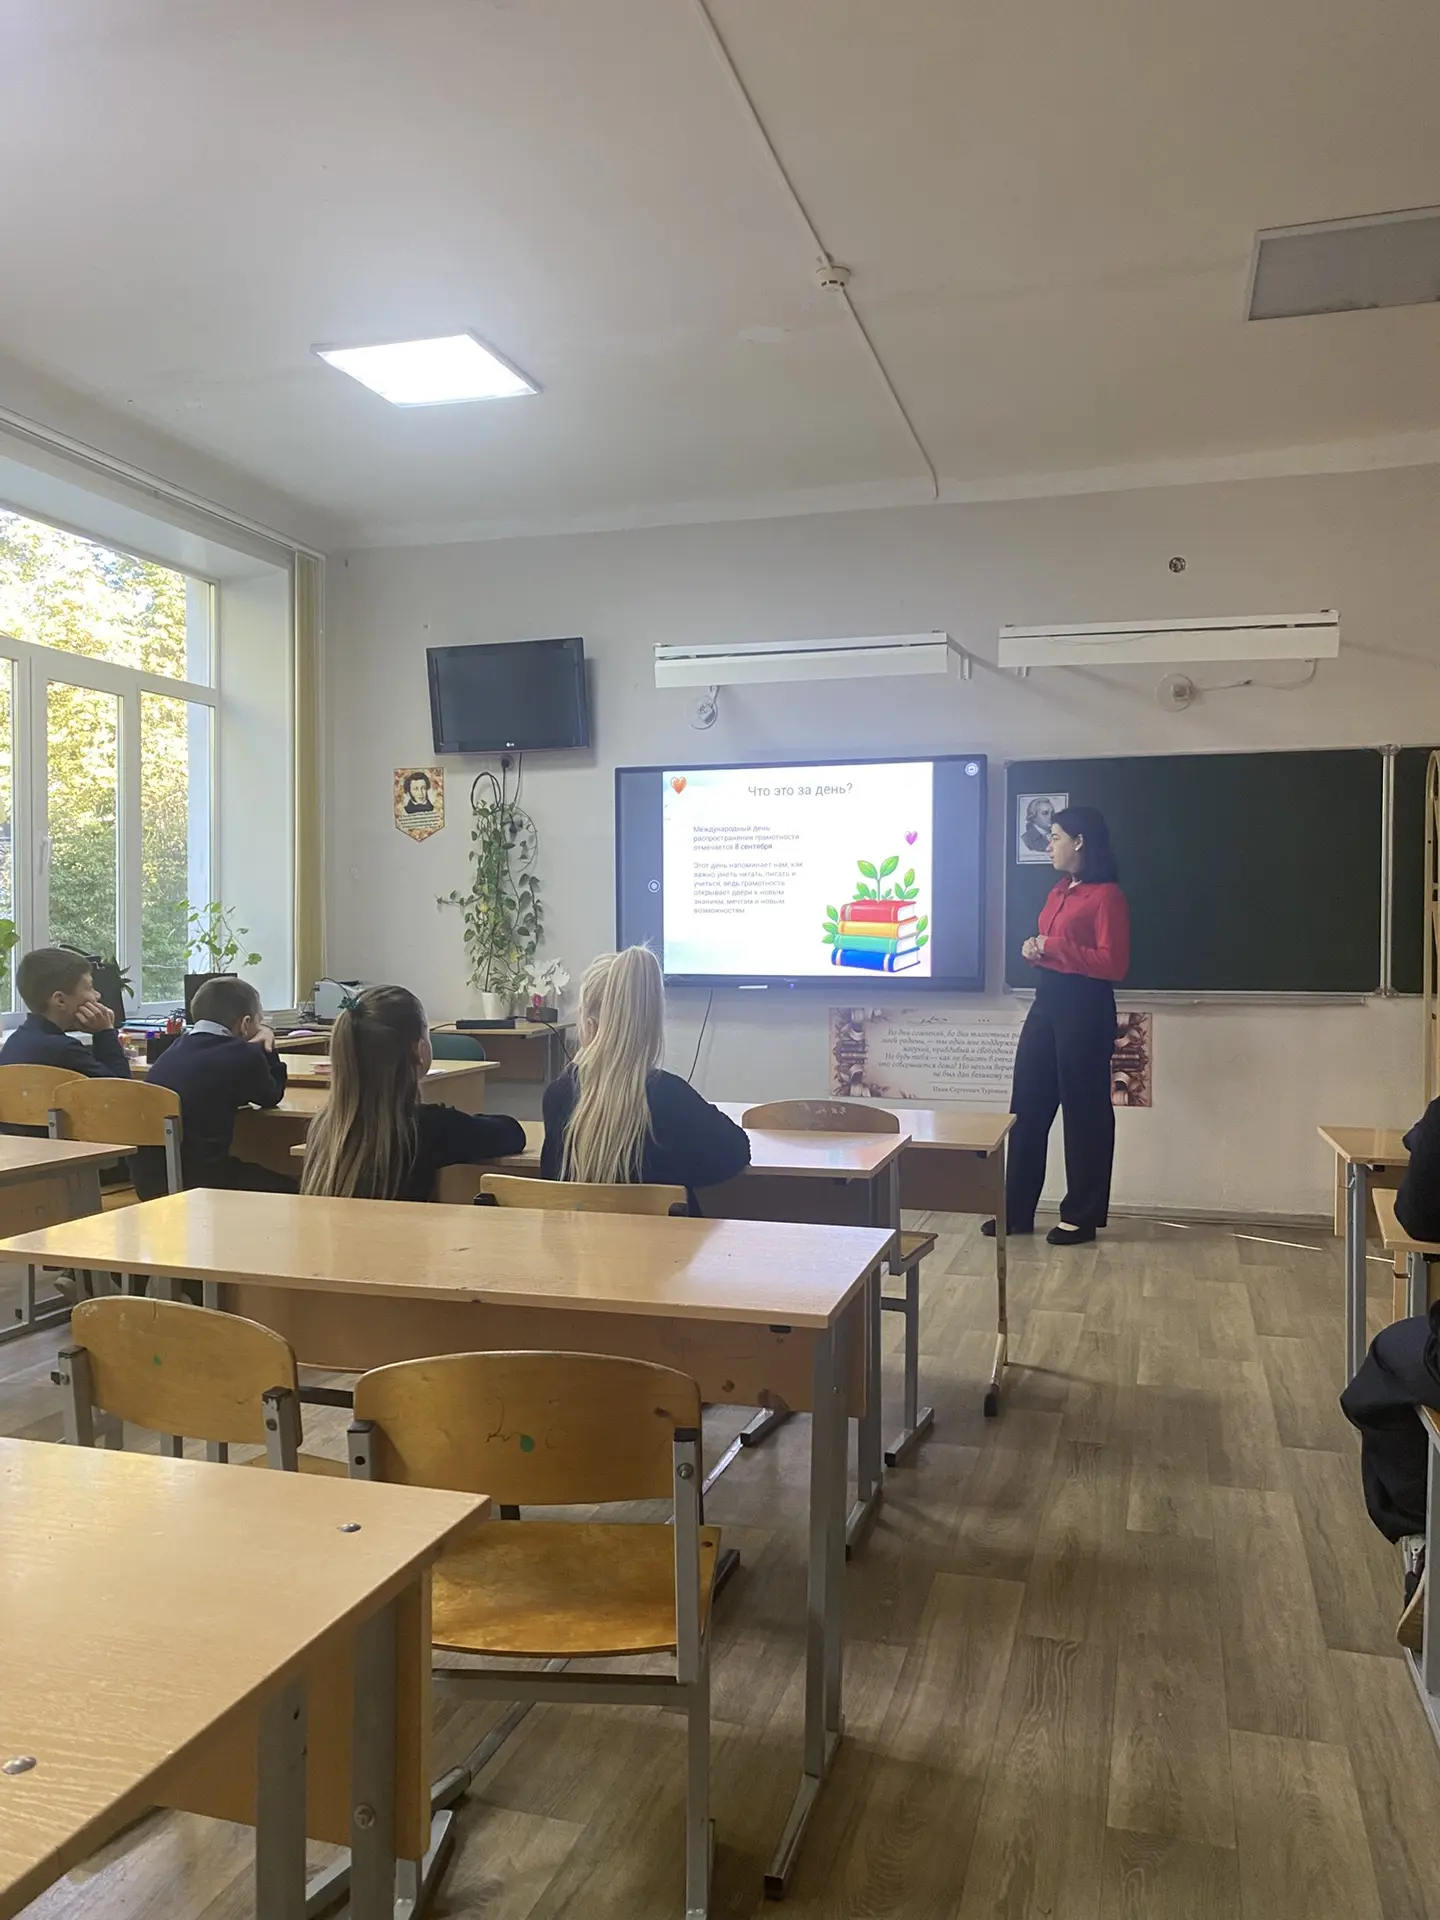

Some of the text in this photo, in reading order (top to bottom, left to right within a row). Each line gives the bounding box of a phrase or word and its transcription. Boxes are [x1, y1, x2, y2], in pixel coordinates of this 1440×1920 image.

[748, 783, 853, 797] Что это за день?
[693, 825, 751, 833] Международный
[711, 862, 728, 870] день
[741, 880, 785, 888] грамотность
